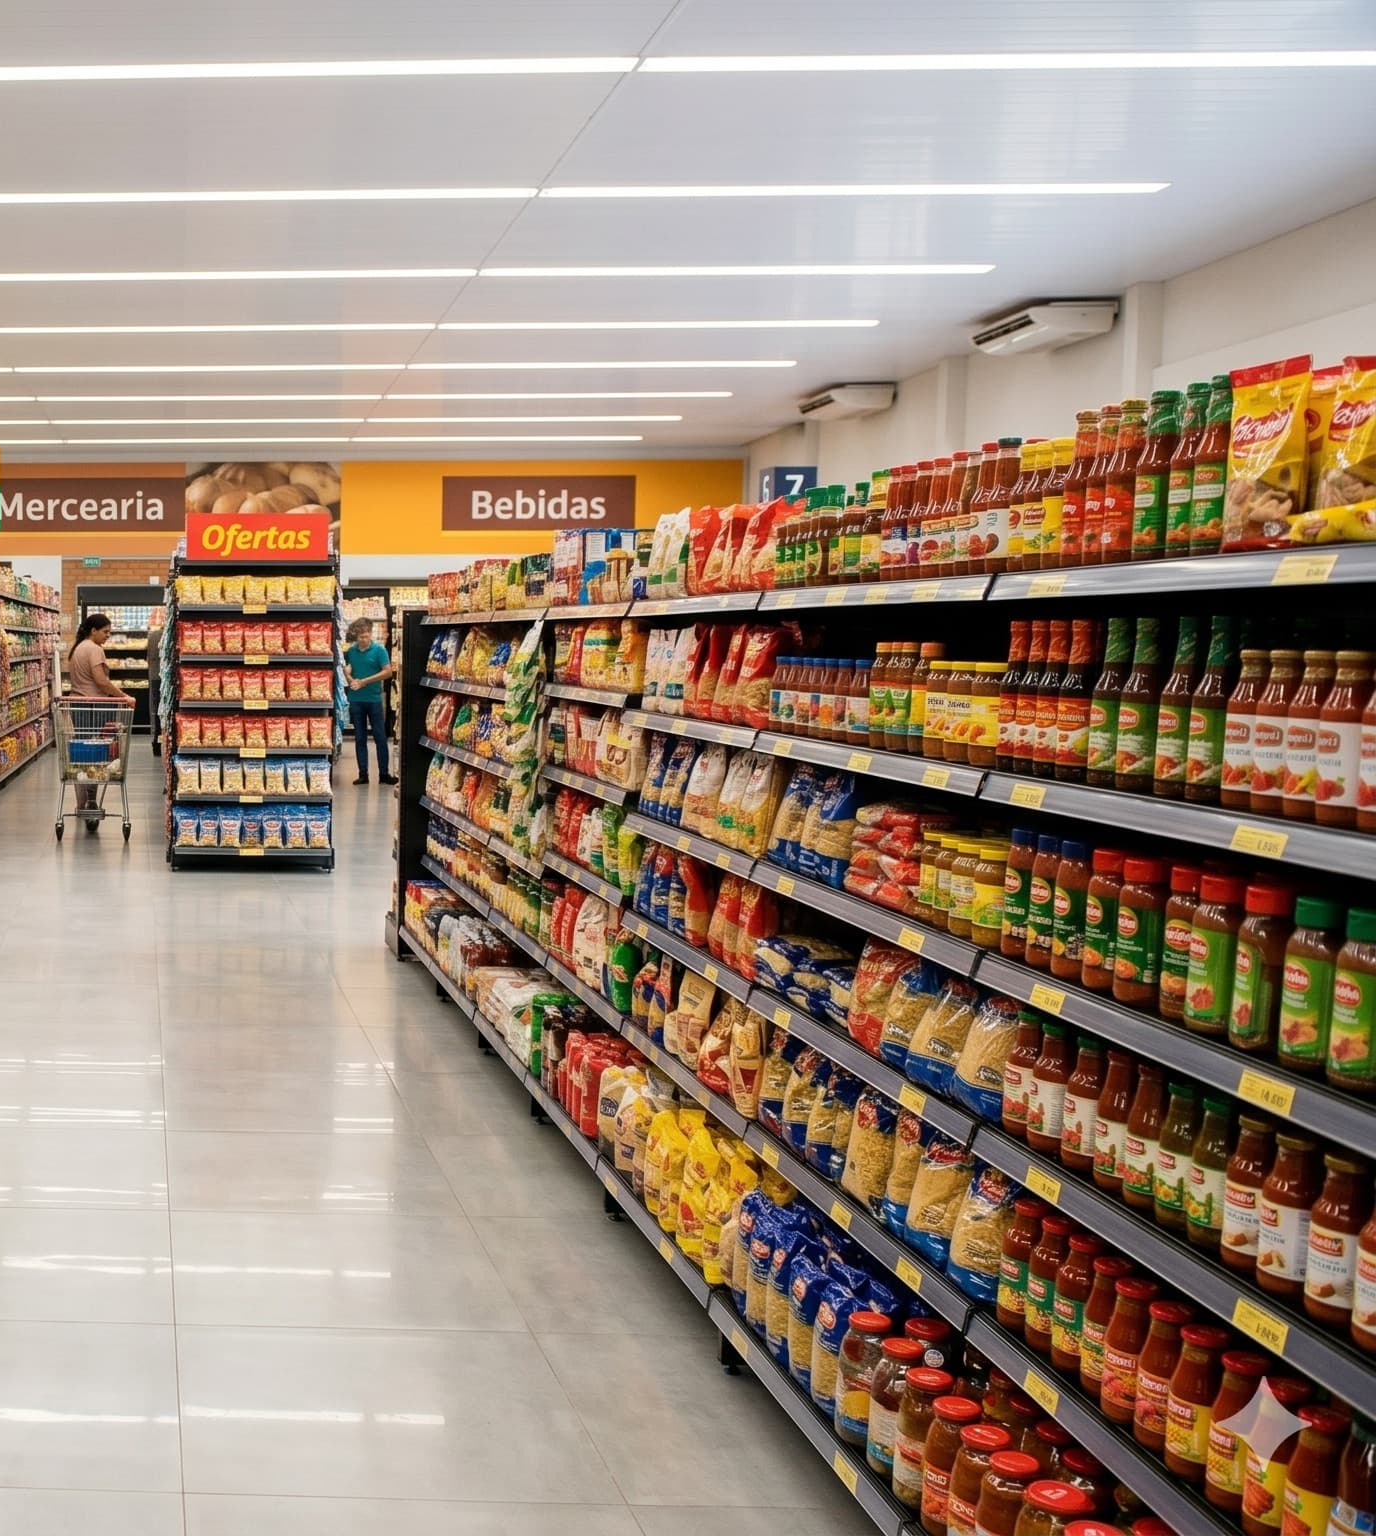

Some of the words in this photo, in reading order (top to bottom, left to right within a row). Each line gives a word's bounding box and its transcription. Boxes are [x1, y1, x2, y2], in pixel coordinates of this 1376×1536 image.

[785, 474, 805, 495] 7
[0, 490, 164, 521] Mercearia
[471, 488, 607, 520] Bebidas
[201, 523, 311, 557] Ofertas
